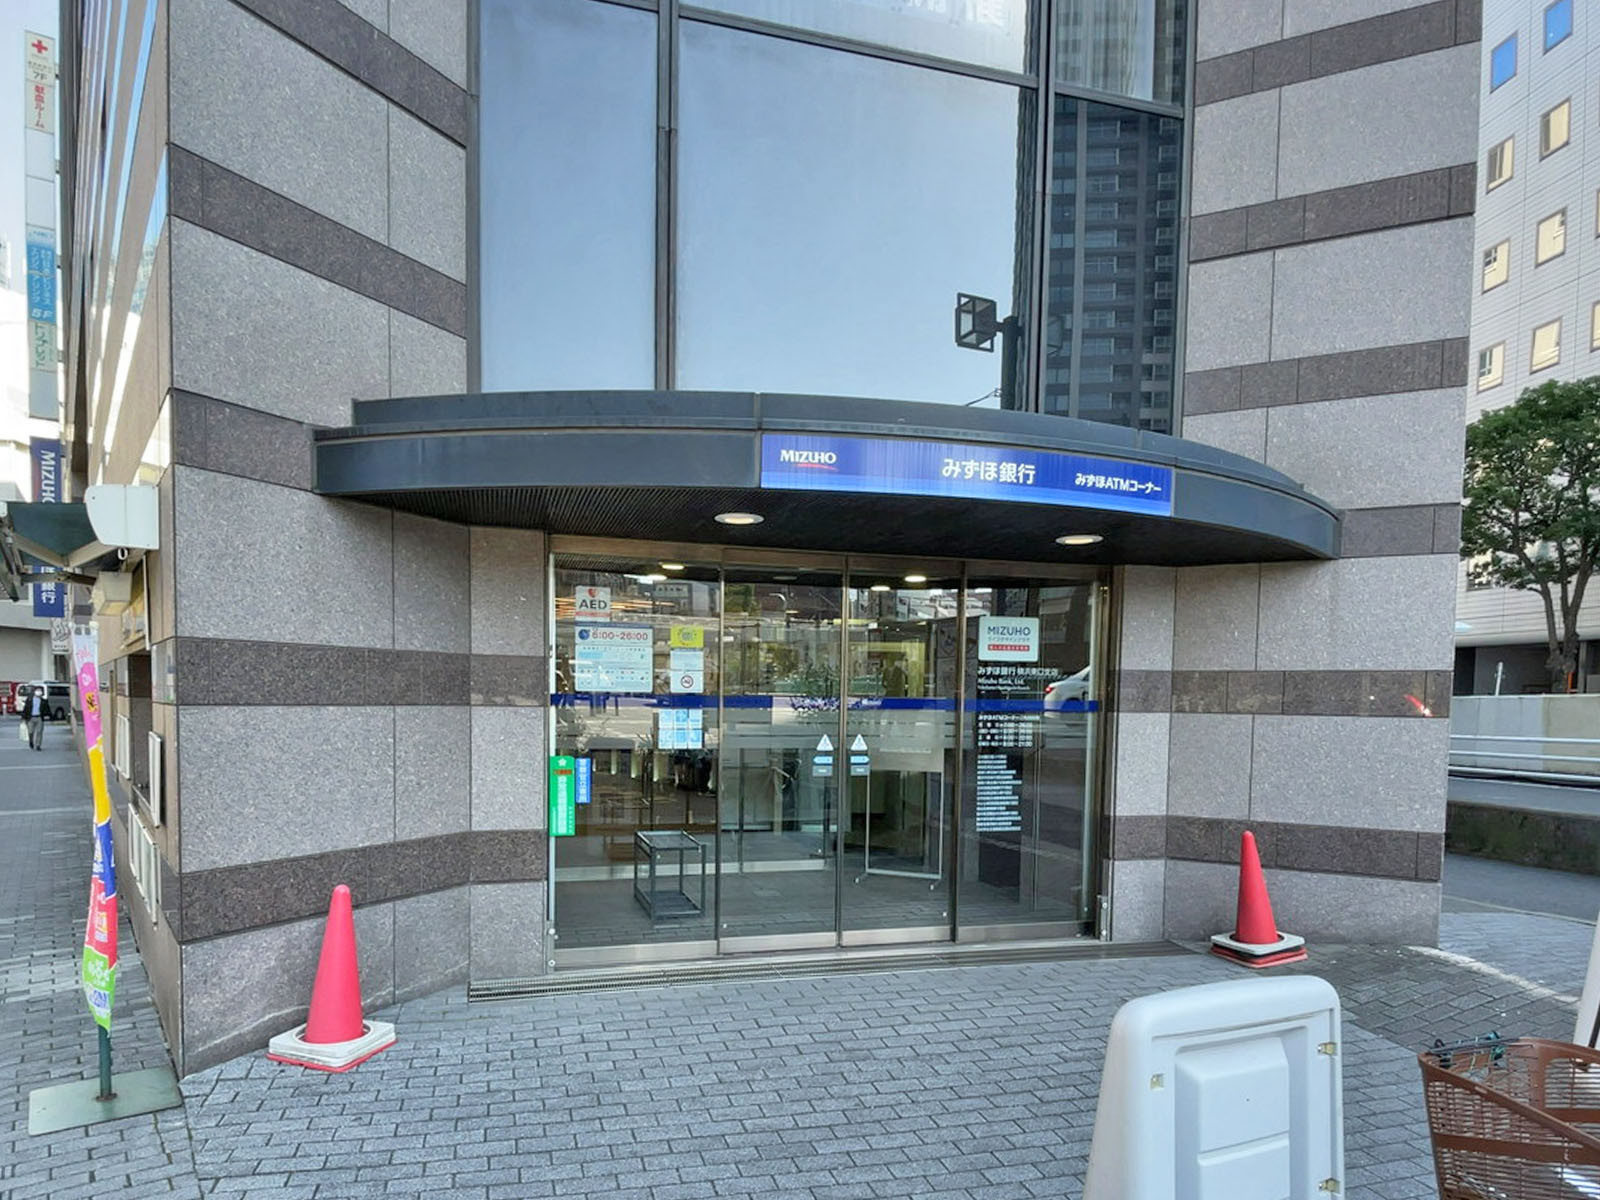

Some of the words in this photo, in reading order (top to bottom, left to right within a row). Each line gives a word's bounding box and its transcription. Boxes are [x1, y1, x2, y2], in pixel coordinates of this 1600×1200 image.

[780, 449, 837, 465] MIZUHO
[942, 458, 1036, 485] みずほ銀行
[1074, 472, 1162, 494] みずほATMコーナー
[579, 599, 608, 610] AED
[987, 626, 1031, 636] MIZUHO
